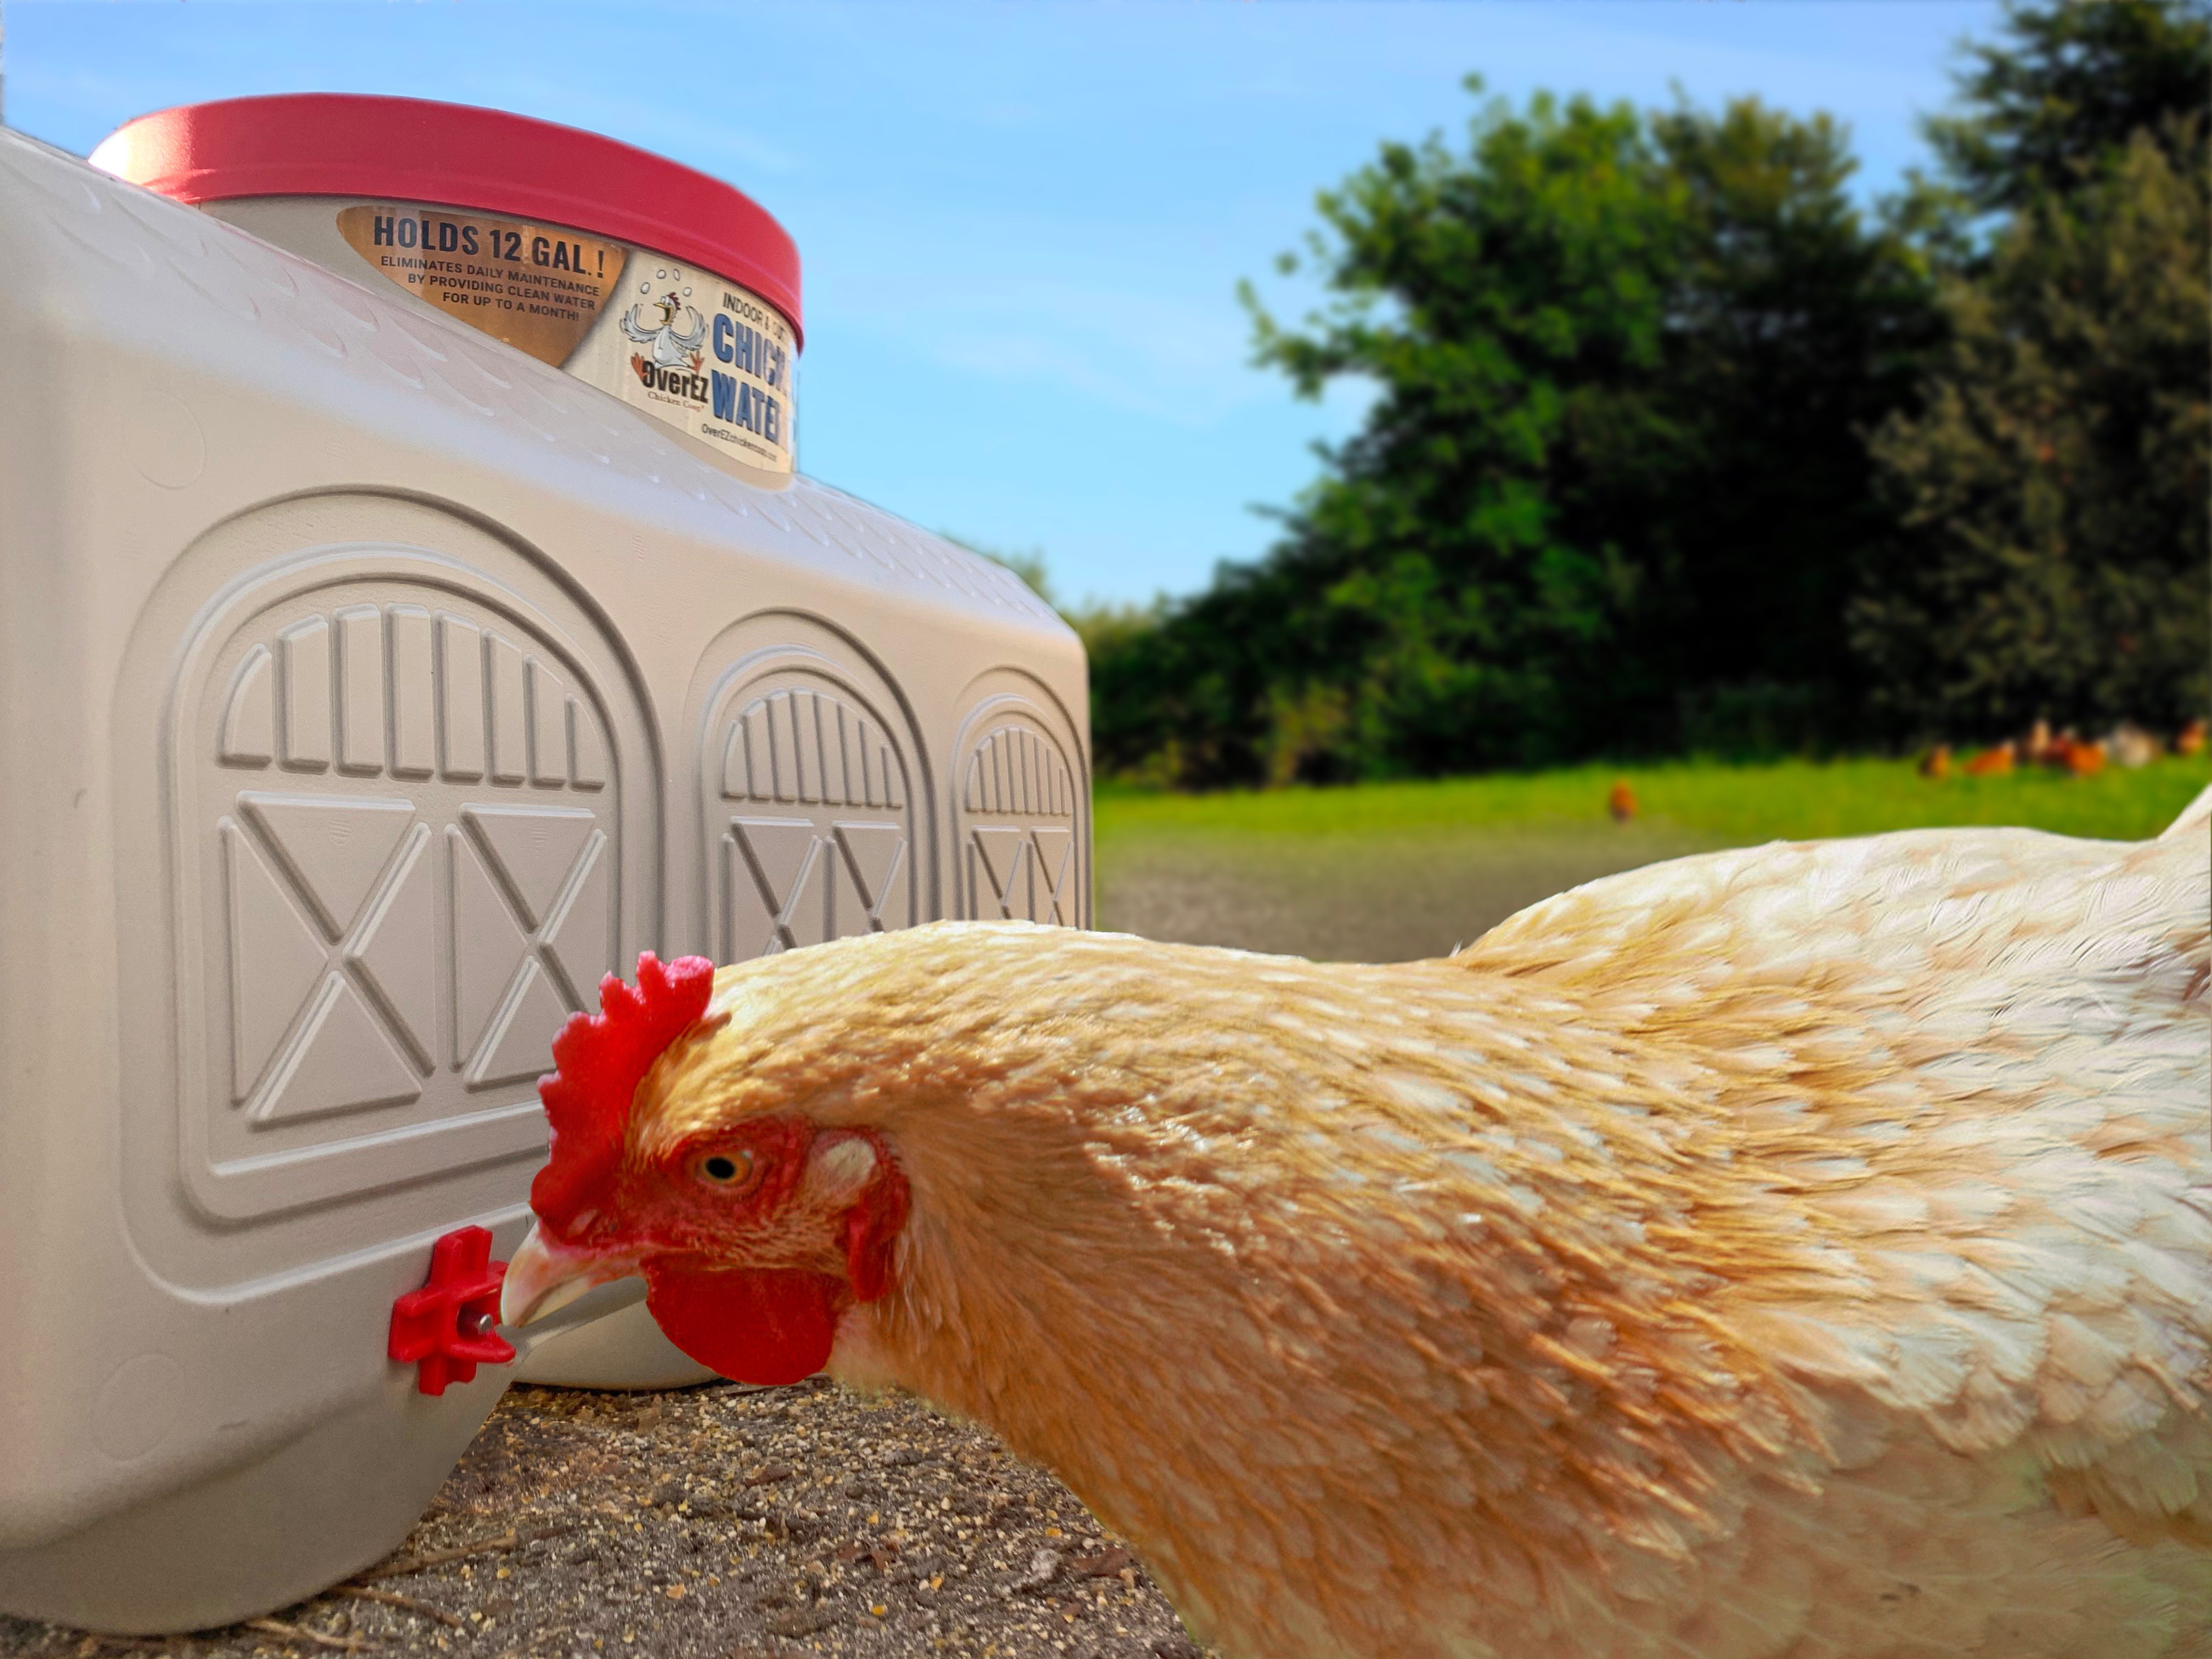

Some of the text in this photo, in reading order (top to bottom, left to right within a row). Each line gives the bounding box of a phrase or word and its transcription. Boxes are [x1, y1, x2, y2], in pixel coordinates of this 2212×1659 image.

[374, 216, 479, 256] HOLDS
[489, 229, 521, 262] 12
[381, 256, 599, 297] ELIMINATES DAILY MAINTENANCE
[408, 273, 595, 310] BY PROVIDING CLEAN WATER
[443, 292, 579, 321] FOR UP TO A MONTH!
[723, 292, 763, 326] INDOOR
[642, 360, 709, 404] OverEZ
